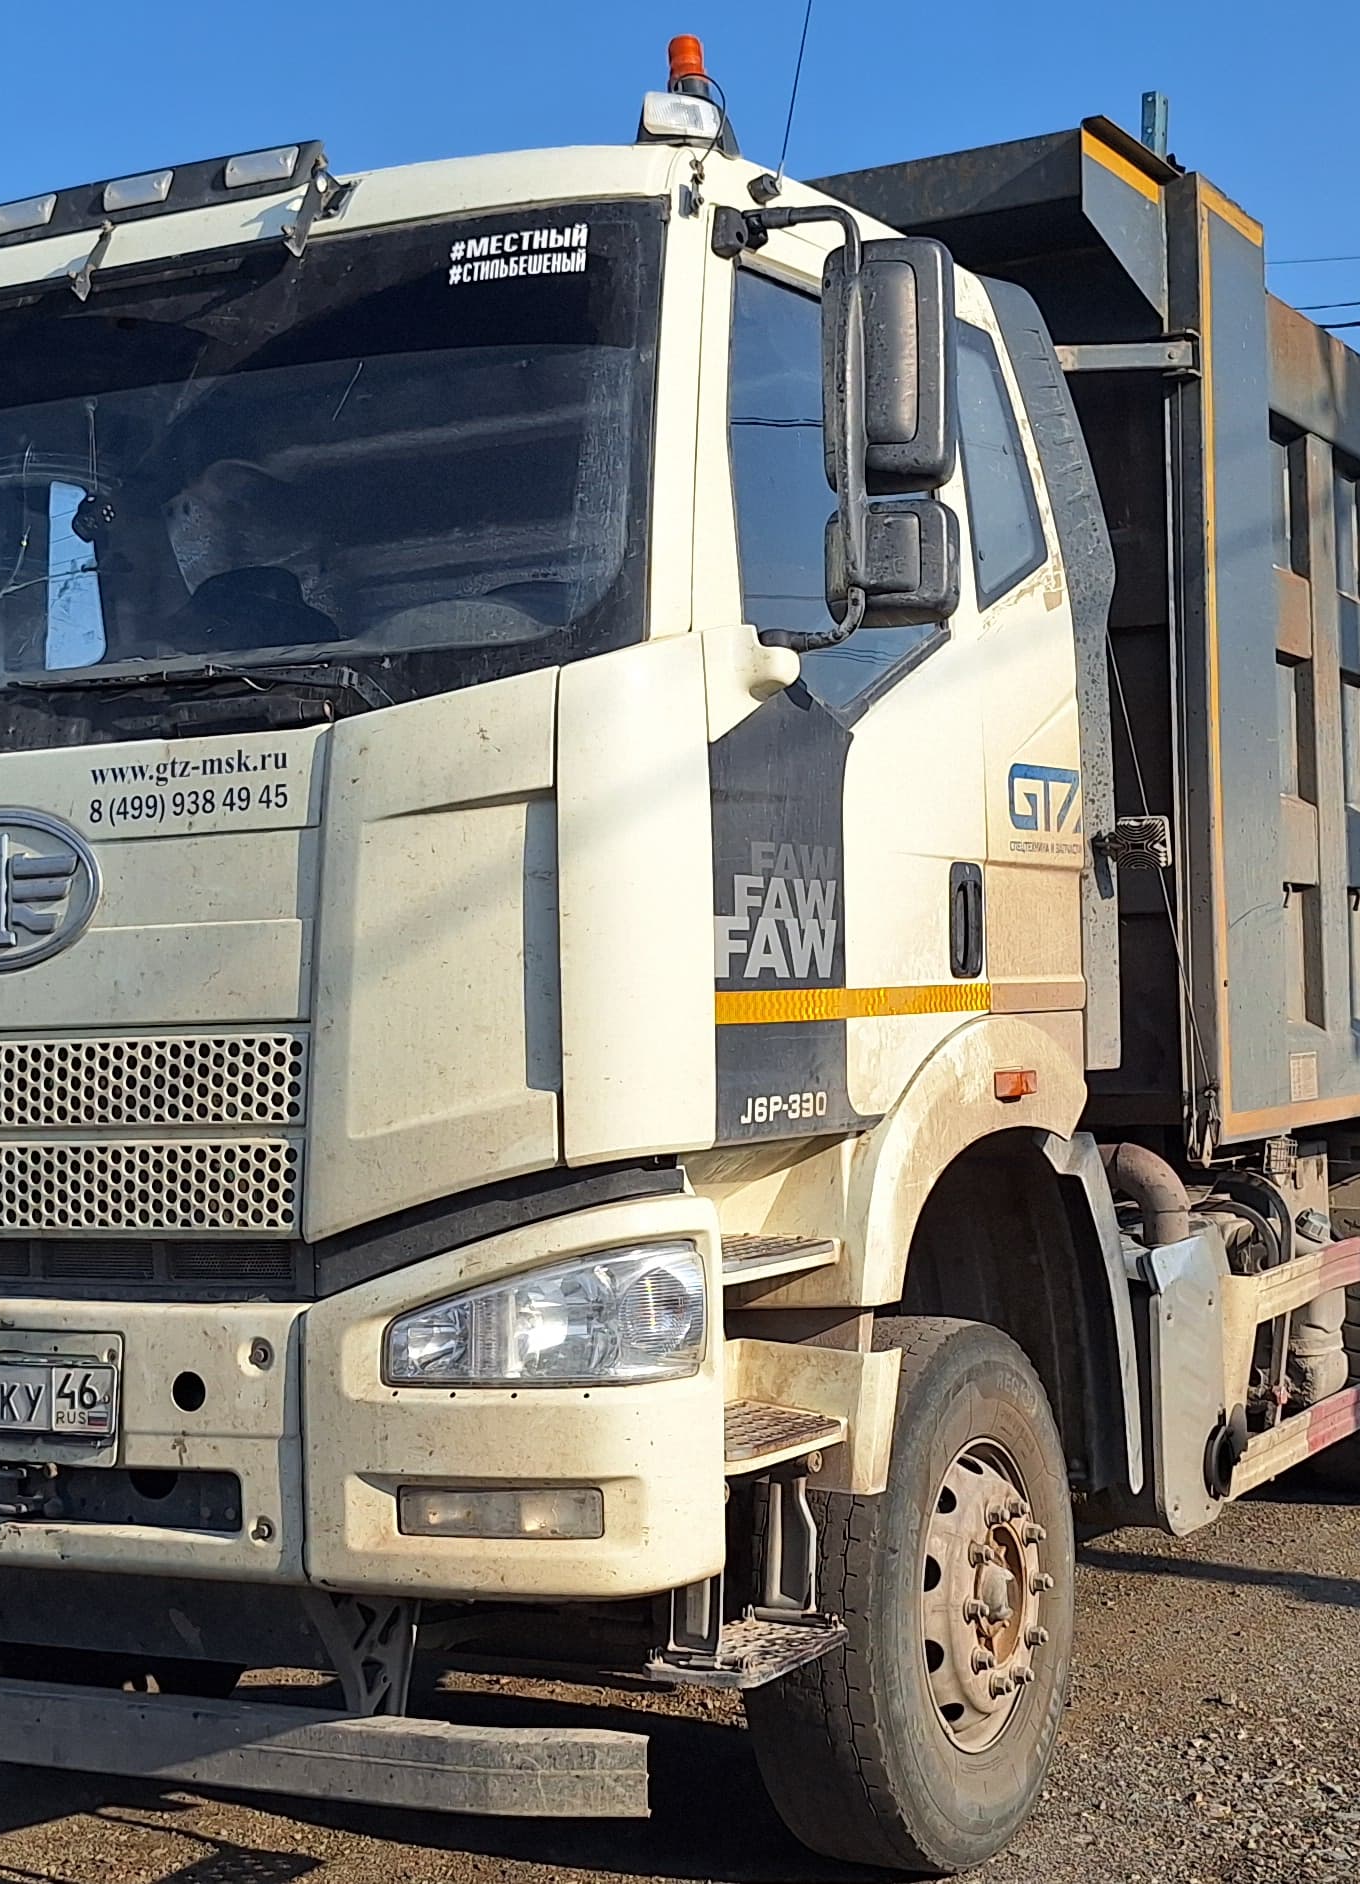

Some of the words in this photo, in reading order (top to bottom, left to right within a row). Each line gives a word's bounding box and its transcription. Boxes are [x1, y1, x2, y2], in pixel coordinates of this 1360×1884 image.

[450, 223, 588, 261] #МЕСТНЫЙ
[448, 248, 587, 285] #СТИЛЬБЕШЕНЫЙ
[90, 749, 288, 787] www.gtz-msk.ru
[90, 799, 102, 823] 8
[109, 794, 166, 827] (499)
[172, 789, 215, 816] 938
[222, 786, 251, 812] 49
[258, 783, 288, 809] 45
[751, 841, 836, 882] FAW
[734, 874, 836, 926] FAW
[714, 915, 837, 979] FAW
[56, 1372, 98, 1410] 46
[56, 1411, 86, 1426] RUS
